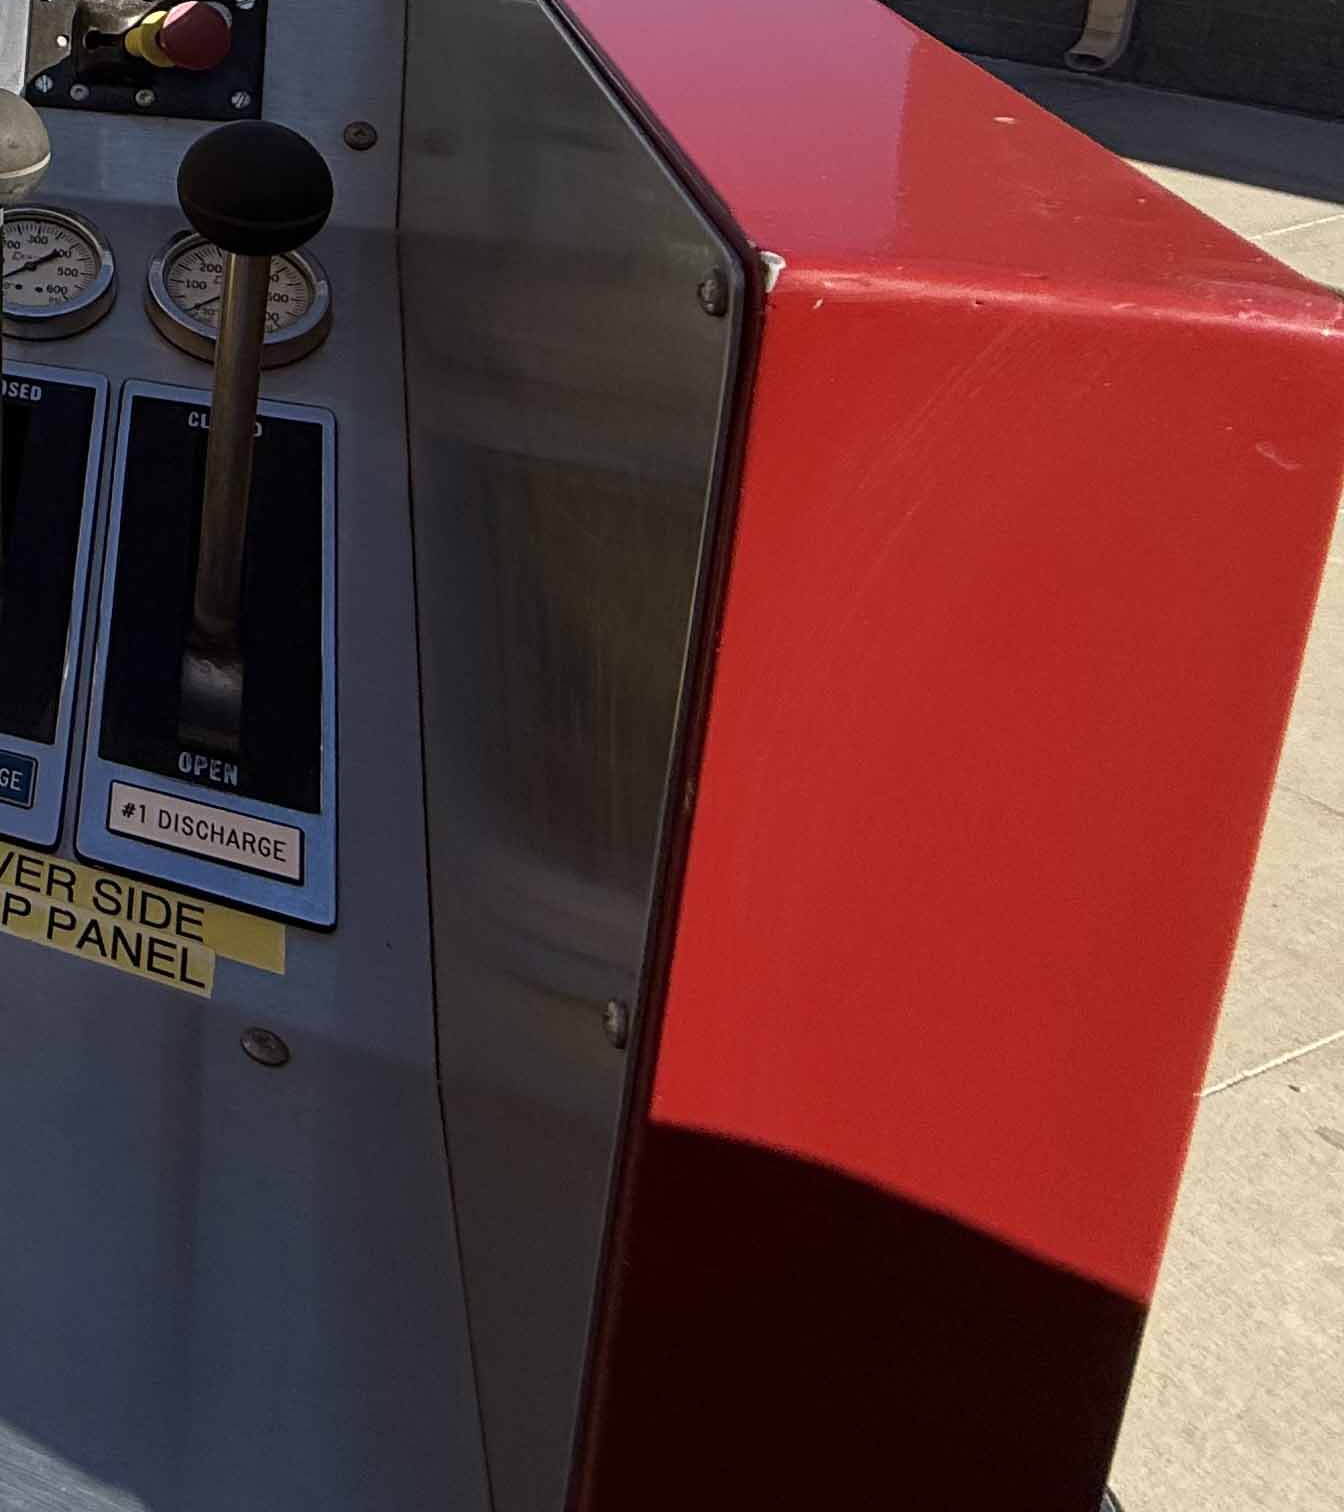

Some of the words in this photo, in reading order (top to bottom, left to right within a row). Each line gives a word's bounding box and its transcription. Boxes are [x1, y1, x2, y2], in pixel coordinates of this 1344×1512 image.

[57, 267, 79, 277] 500
[199, 263, 222, 274] 200
[46, 285, 68, 295] 600
[185, 279, 207, 290] 100
[178, 751, 239, 787] OPEN
[122, 802, 146, 824] #1
[158, 809, 288, 863] DISCHARGE
[92, 877, 205, 943] SIDE
[46, 905, 206, 989] PANEL
